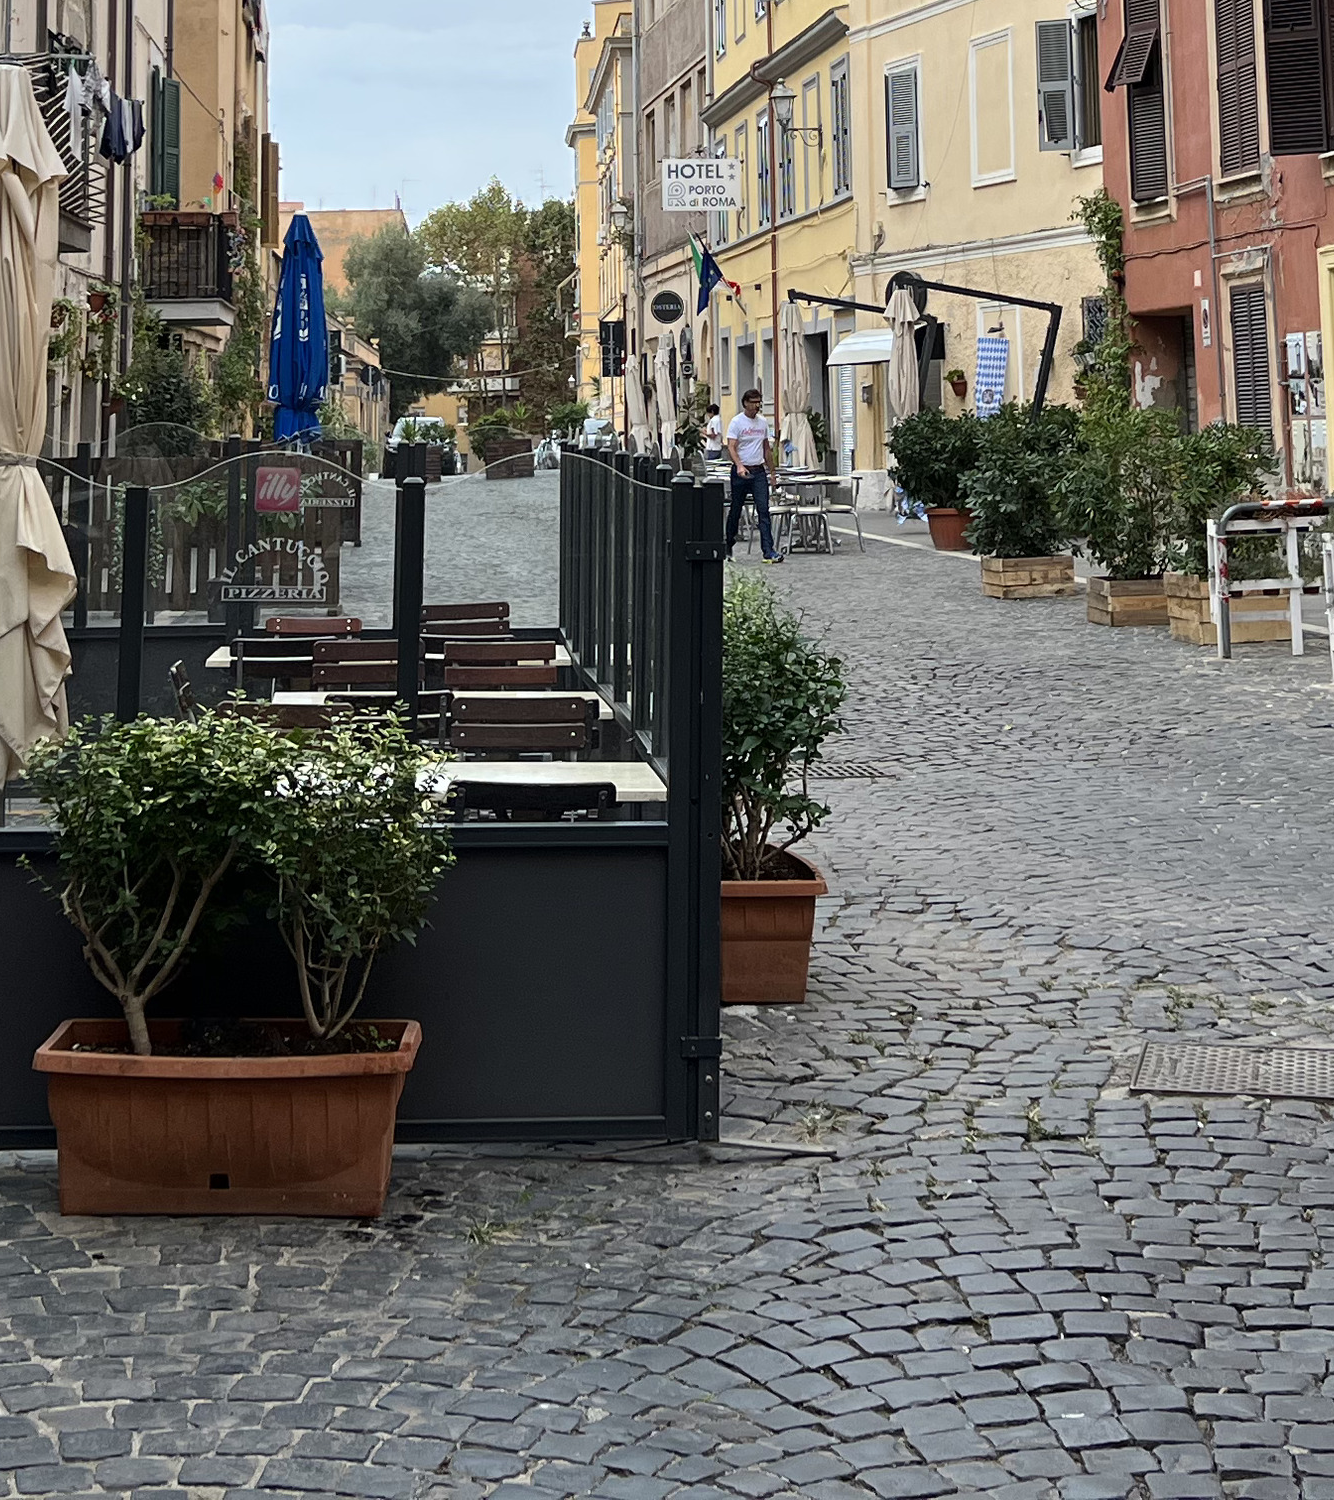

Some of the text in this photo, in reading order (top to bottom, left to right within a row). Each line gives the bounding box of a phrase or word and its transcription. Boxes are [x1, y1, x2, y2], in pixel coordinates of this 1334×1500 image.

[667, 163, 724, 179] HOTEL
[689, 185, 726, 195] PORTO
[689, 197, 737, 207] di ROMA
[652, 303, 682, 311] OSTERIA
[258, 473, 298, 507] illy
[220, 537, 330, 585] IL CANTUCCIO
[228, 587, 322, 600] PIZZERIA
